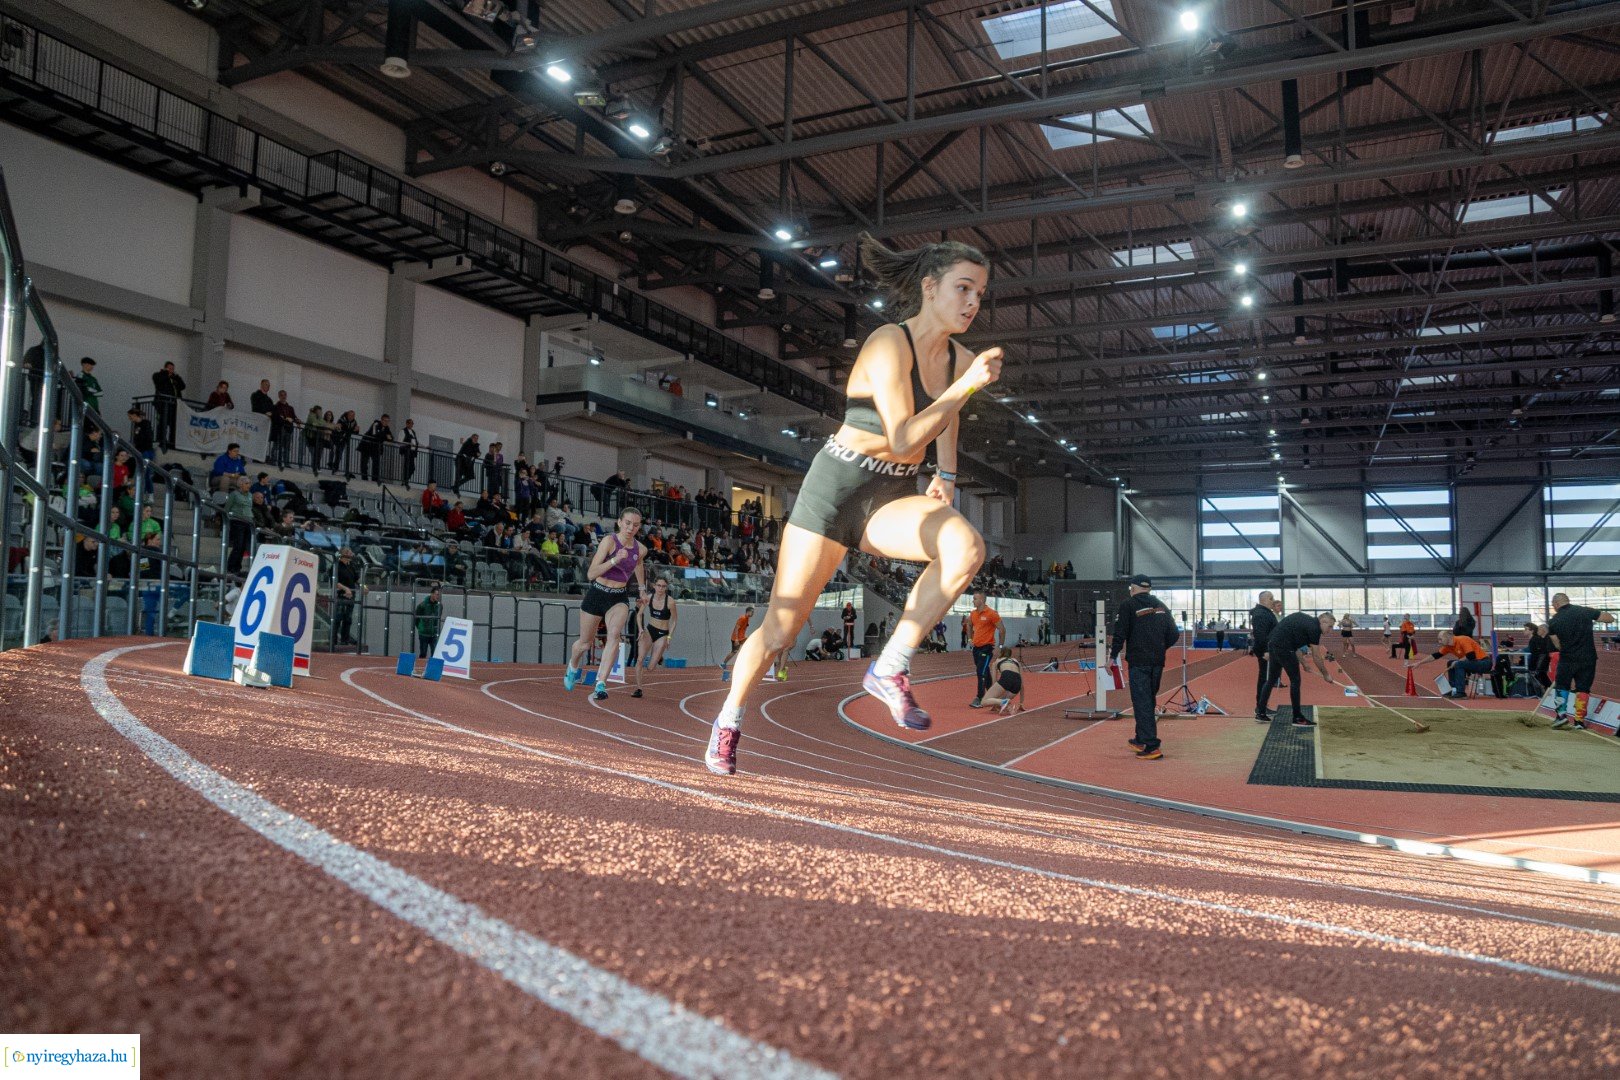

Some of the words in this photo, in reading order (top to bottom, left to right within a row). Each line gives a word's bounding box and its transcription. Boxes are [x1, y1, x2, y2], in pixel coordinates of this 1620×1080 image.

[824, 439, 859, 462] PRO
[860, 456, 905, 476] NIKE
[240, 565, 274, 636] 6
[593, 582, 609, 593] NIKE
[280, 572, 310, 643] 6
[441, 628, 468, 662] 5
